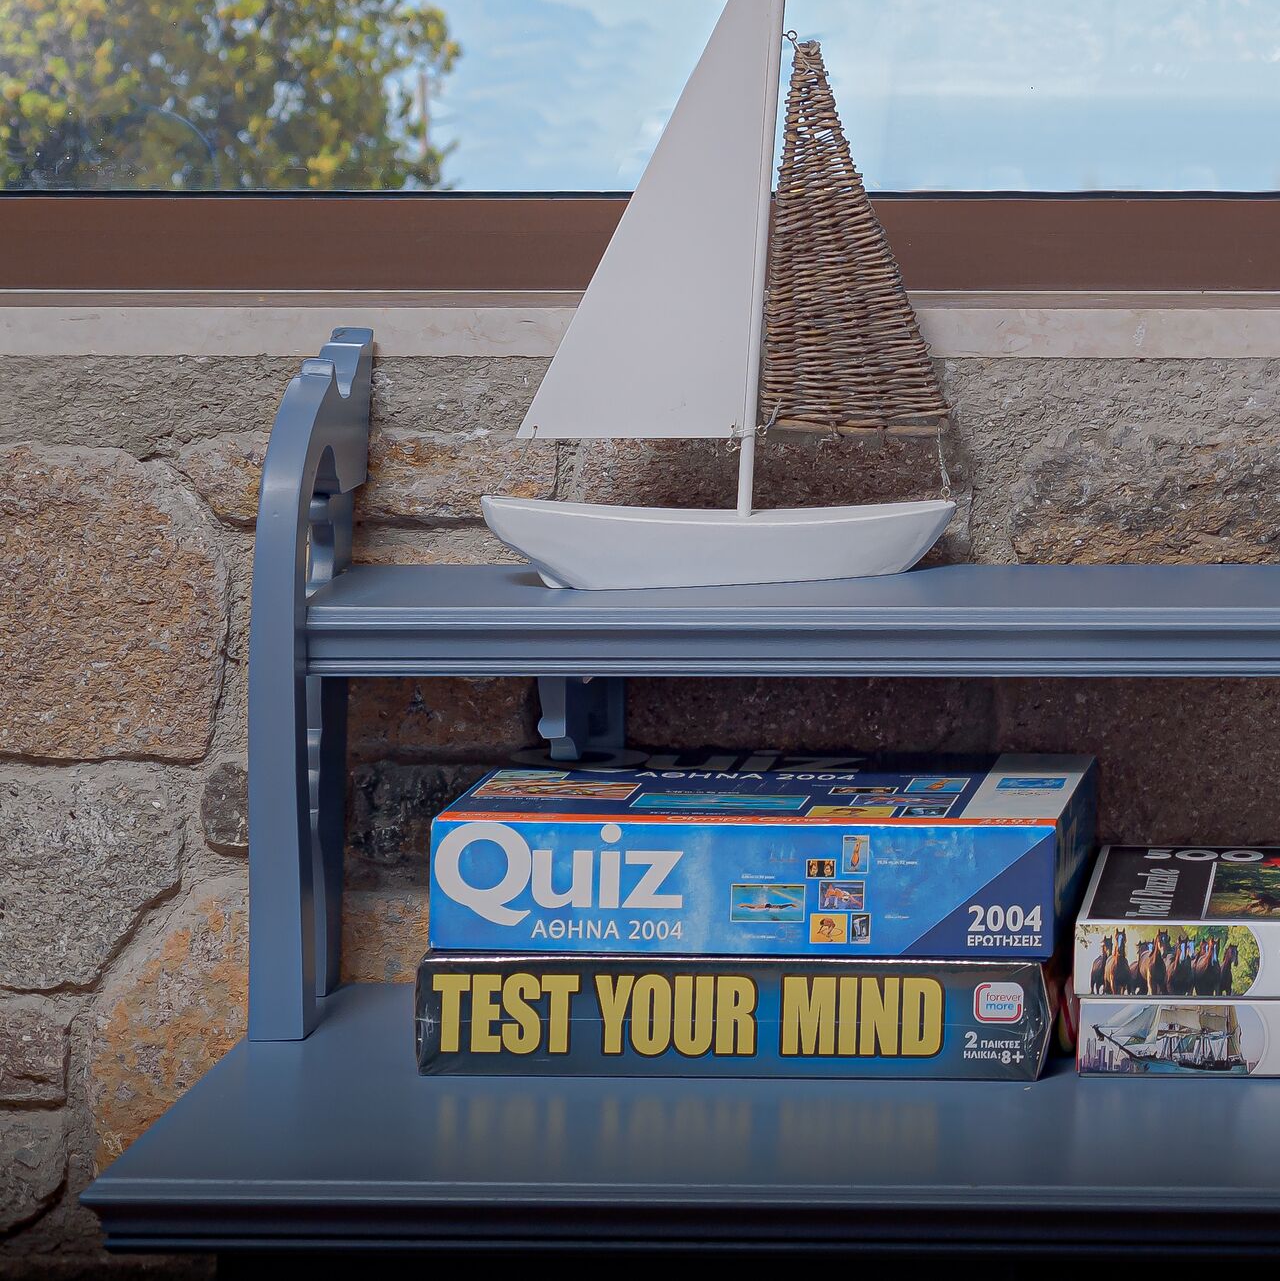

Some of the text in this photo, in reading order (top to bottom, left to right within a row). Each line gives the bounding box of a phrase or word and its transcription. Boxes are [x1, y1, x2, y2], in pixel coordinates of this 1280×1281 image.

[776, 772, 855, 781] 2004
[1143, 849, 1264, 861] 500
[434, 822, 683, 926] Quiz
[1125, 868, 1180, 917] Trefl Puzzle
[967, 904, 1043, 933] 2004
[531, 920, 684, 940] ΑΘΗΝΑ 2004
[966, 933, 1043, 948] ΕΡΩΤΗΣΕΙΣ
[986, 992, 1021, 1002] forever
[432, 973, 944, 1057] TEST YOUR MIND
[964, 1031, 1021, 1049] 2 ΠΑΙΚΤΕΣ
